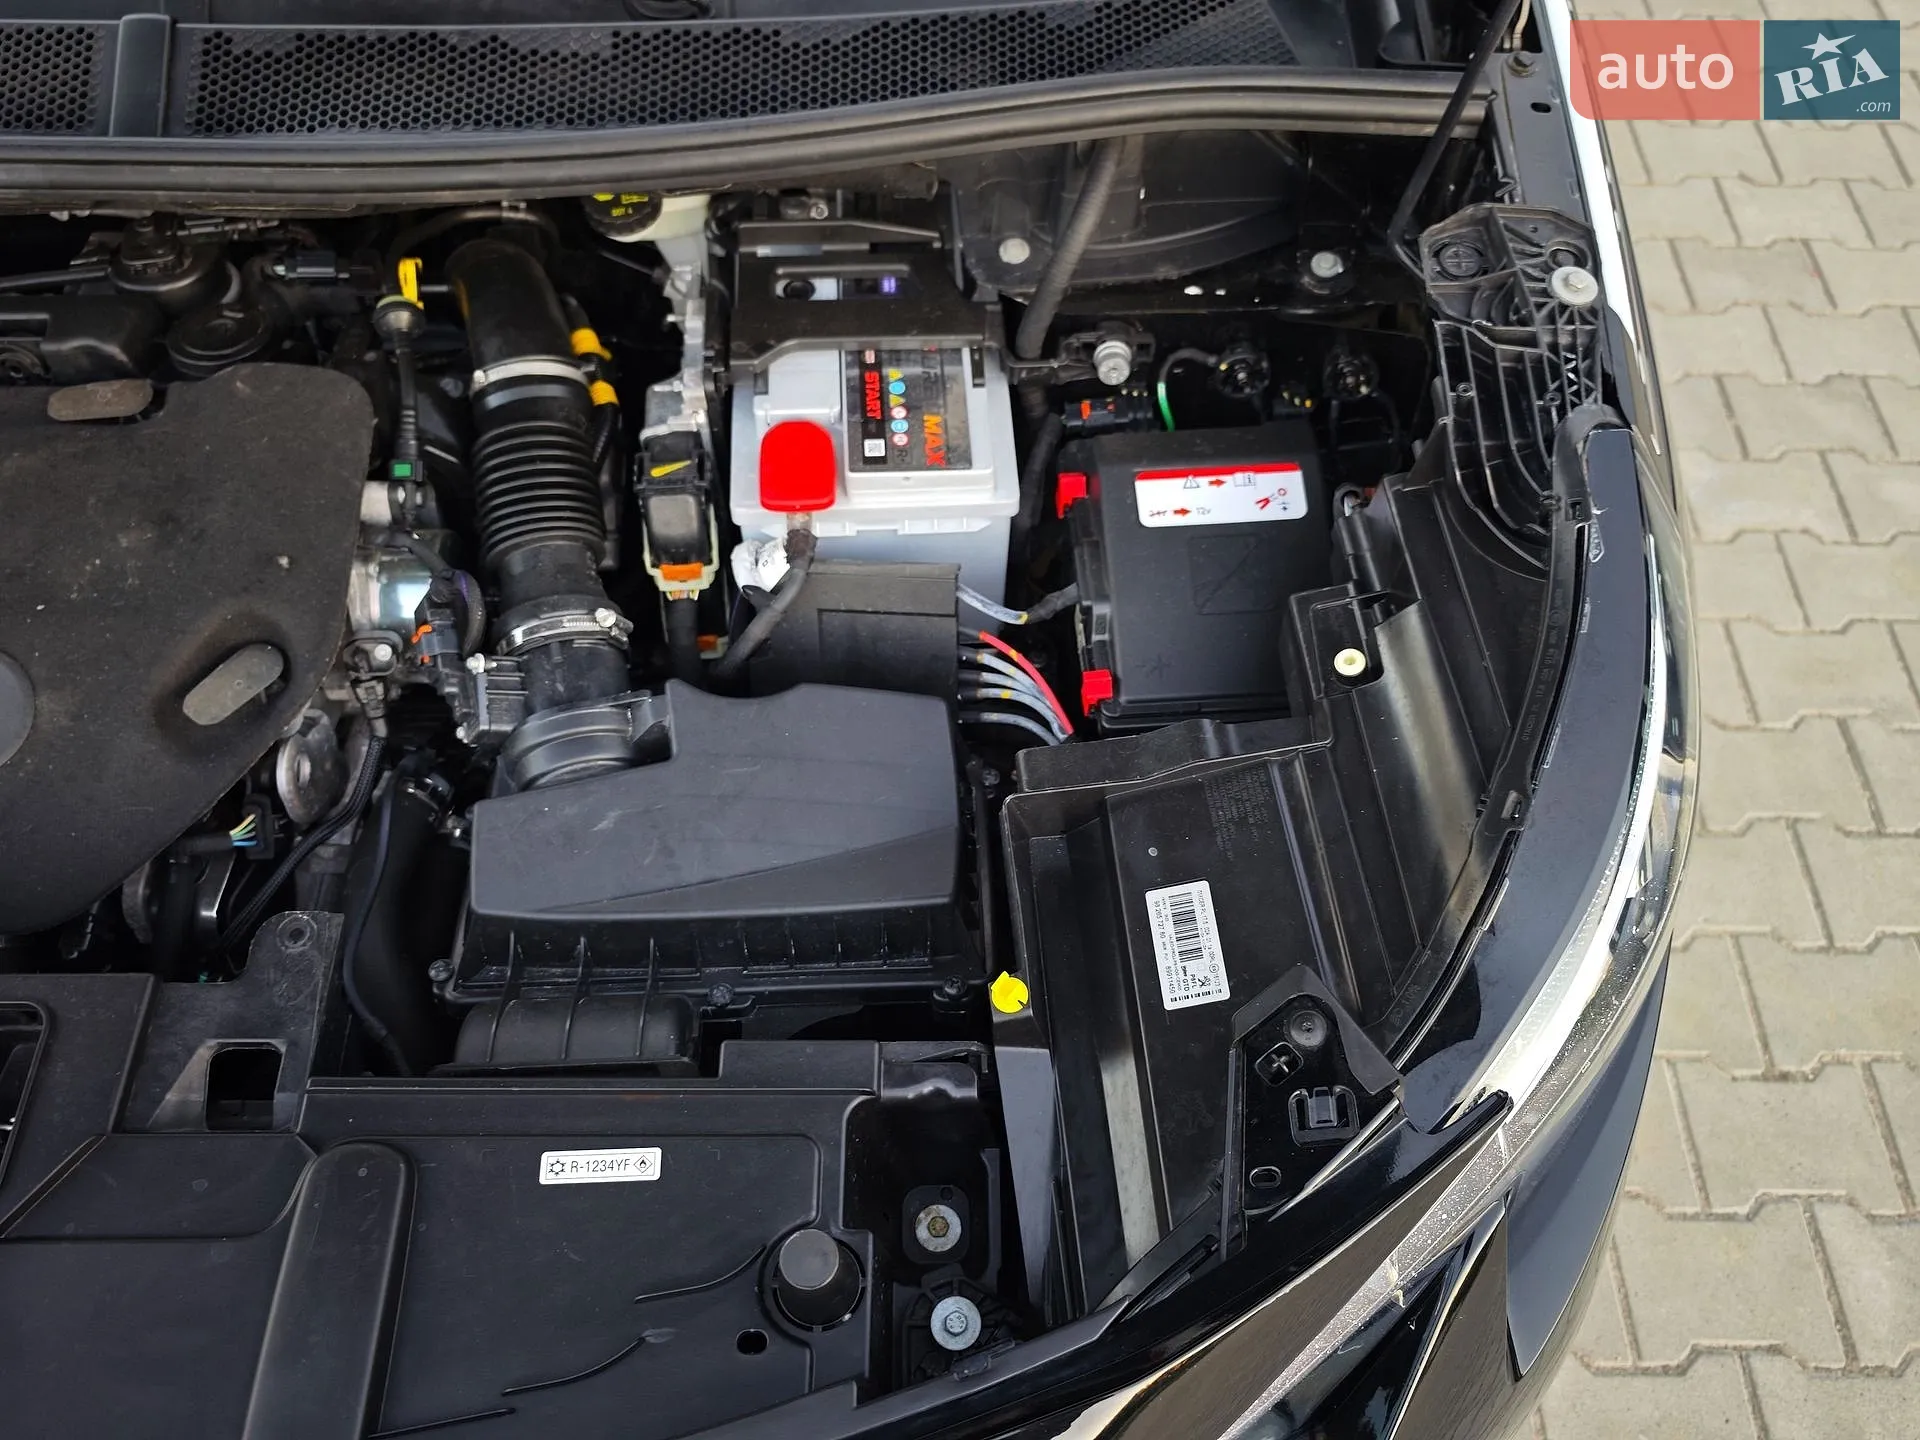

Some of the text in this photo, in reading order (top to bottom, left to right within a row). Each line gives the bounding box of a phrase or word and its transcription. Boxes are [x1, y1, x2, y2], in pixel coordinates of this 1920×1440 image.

[864, 371, 881, 419] START
[922, 414, 947, 468] MAX
[570, 1158, 630, 1173] R-1234YF
